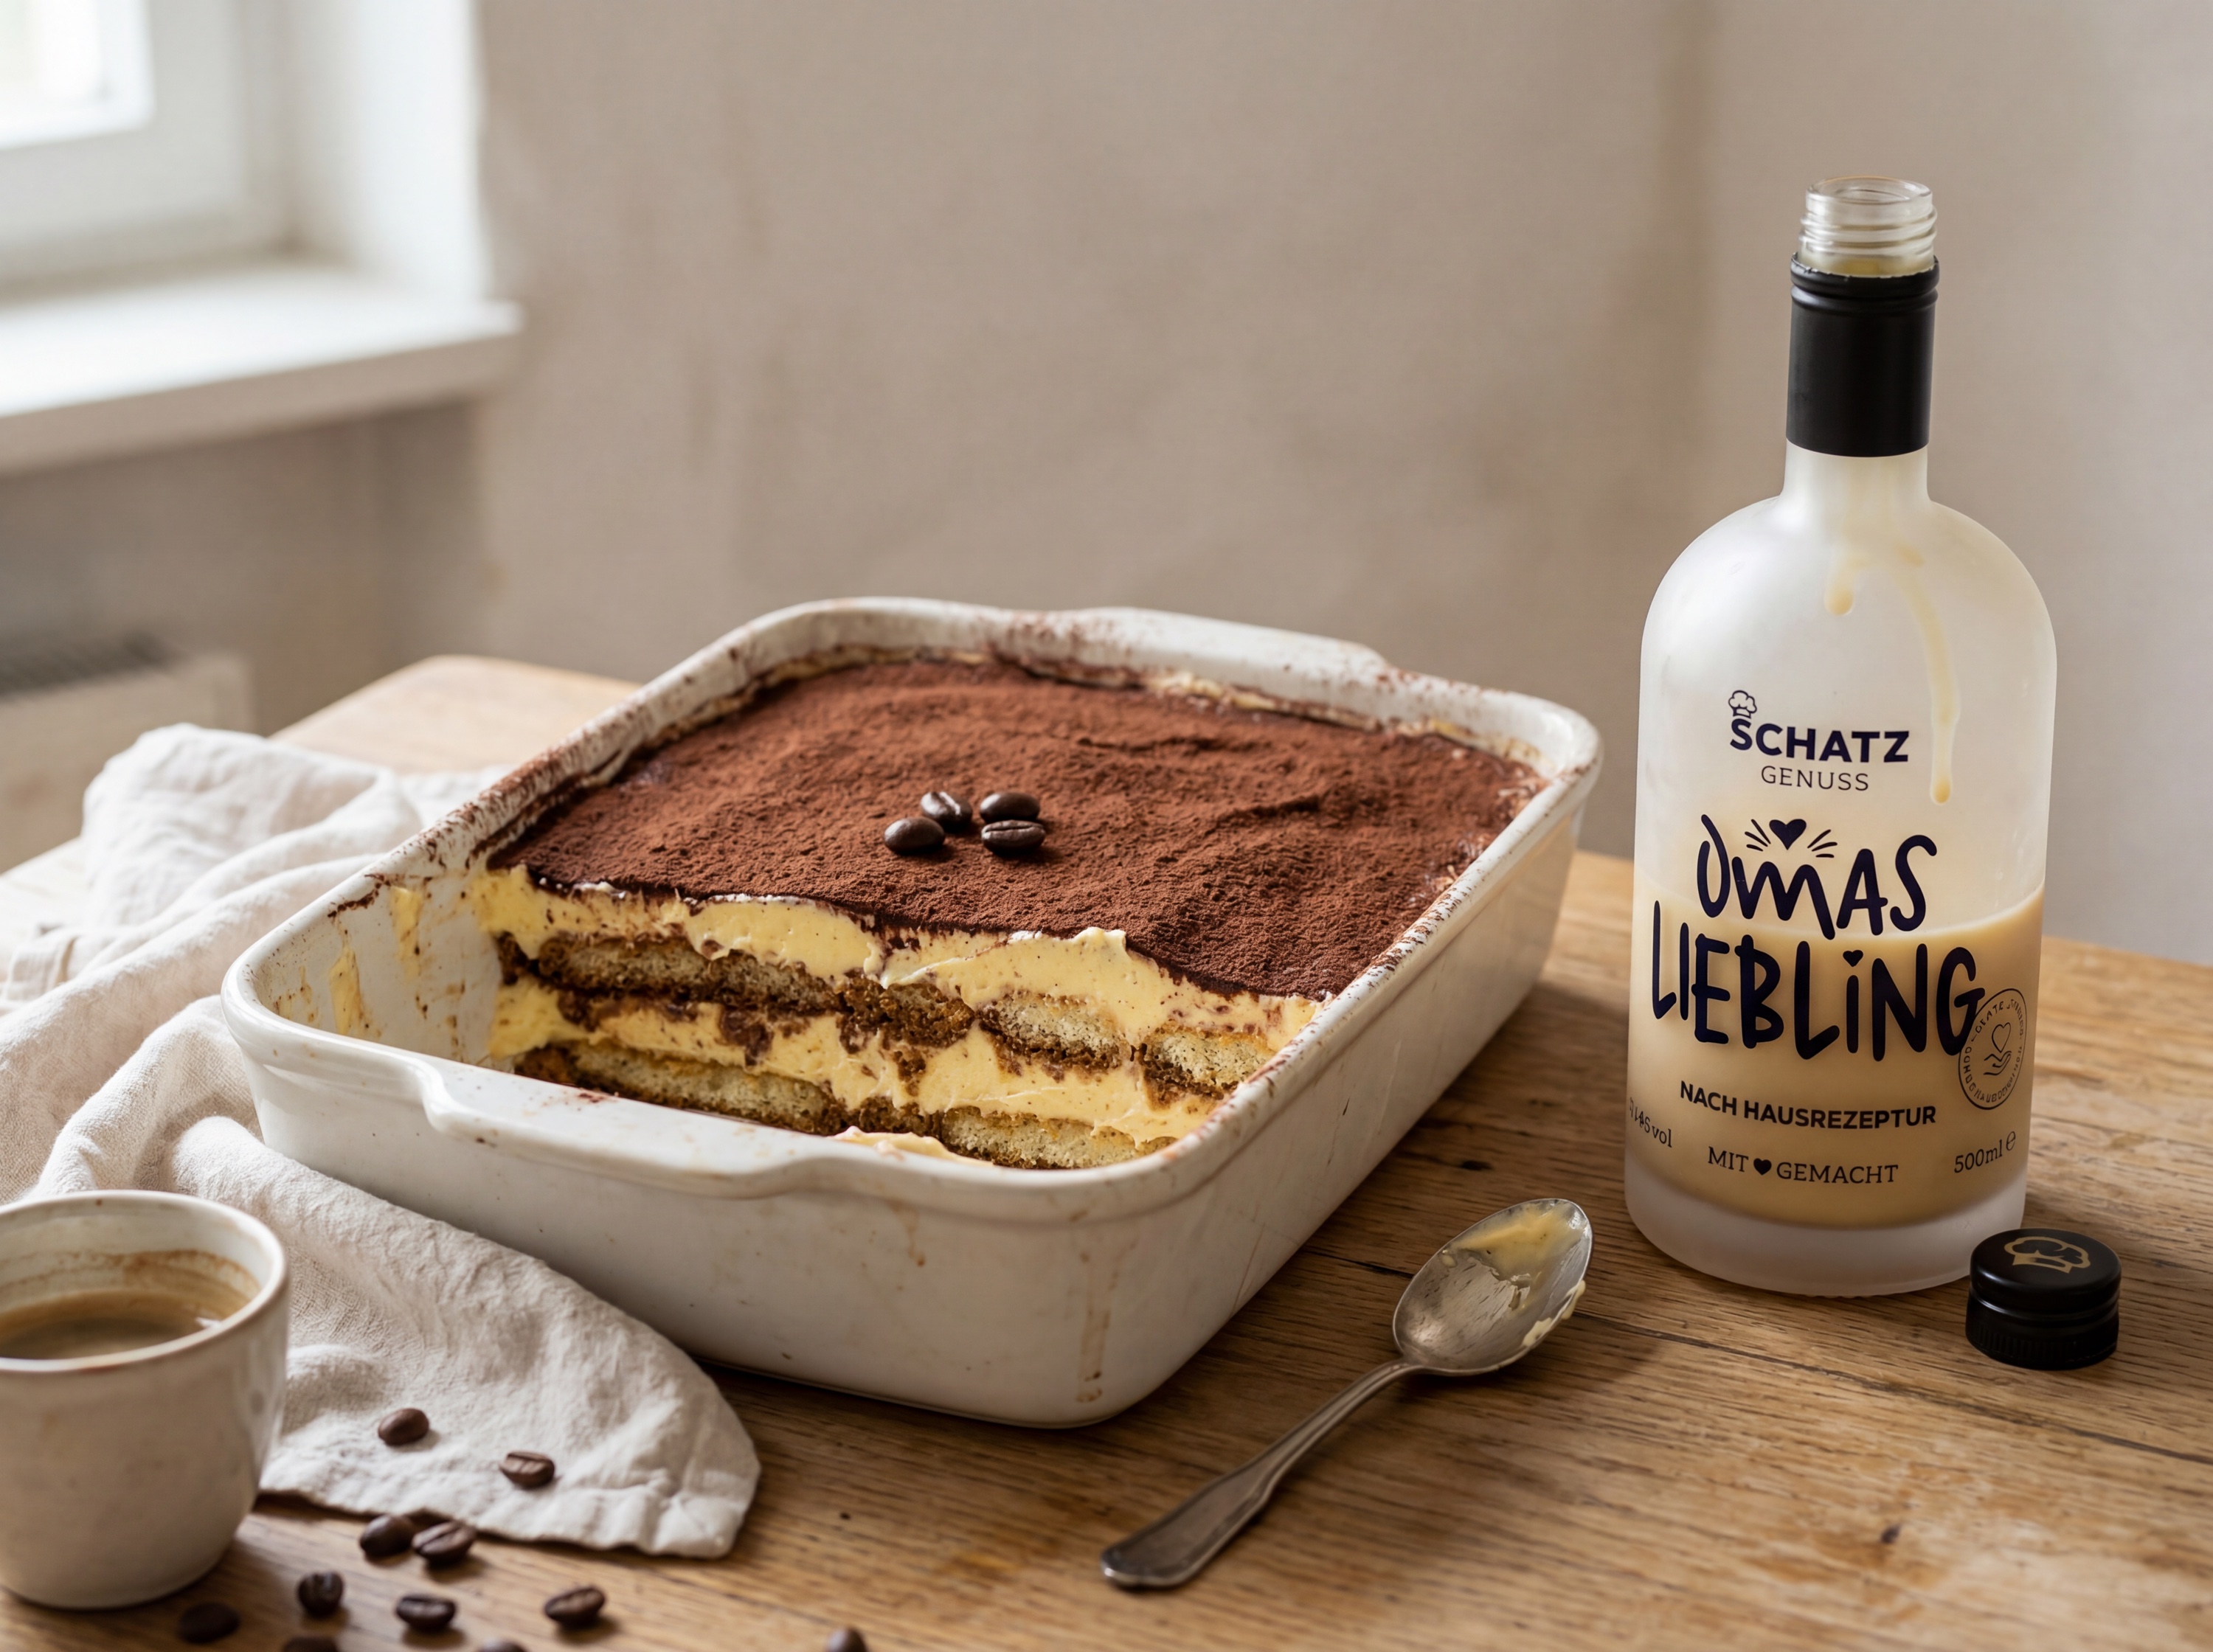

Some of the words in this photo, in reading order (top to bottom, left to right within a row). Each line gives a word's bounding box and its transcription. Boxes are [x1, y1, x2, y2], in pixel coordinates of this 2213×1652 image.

[1730, 718, 1910, 763] SCHATZ
[1761, 766, 1869, 791] GENUSS
[1680, 1080, 1737, 1116] NACH
[1743, 1100, 1936, 1129] HAUSREZEPTUR
[1652, 1128, 1672, 1148] vol
[1708, 1146, 1749, 1173] MIT
[1776, 1162, 1899, 1184] GEMACHT
[1953, 1139, 2003, 1174] 500ml
